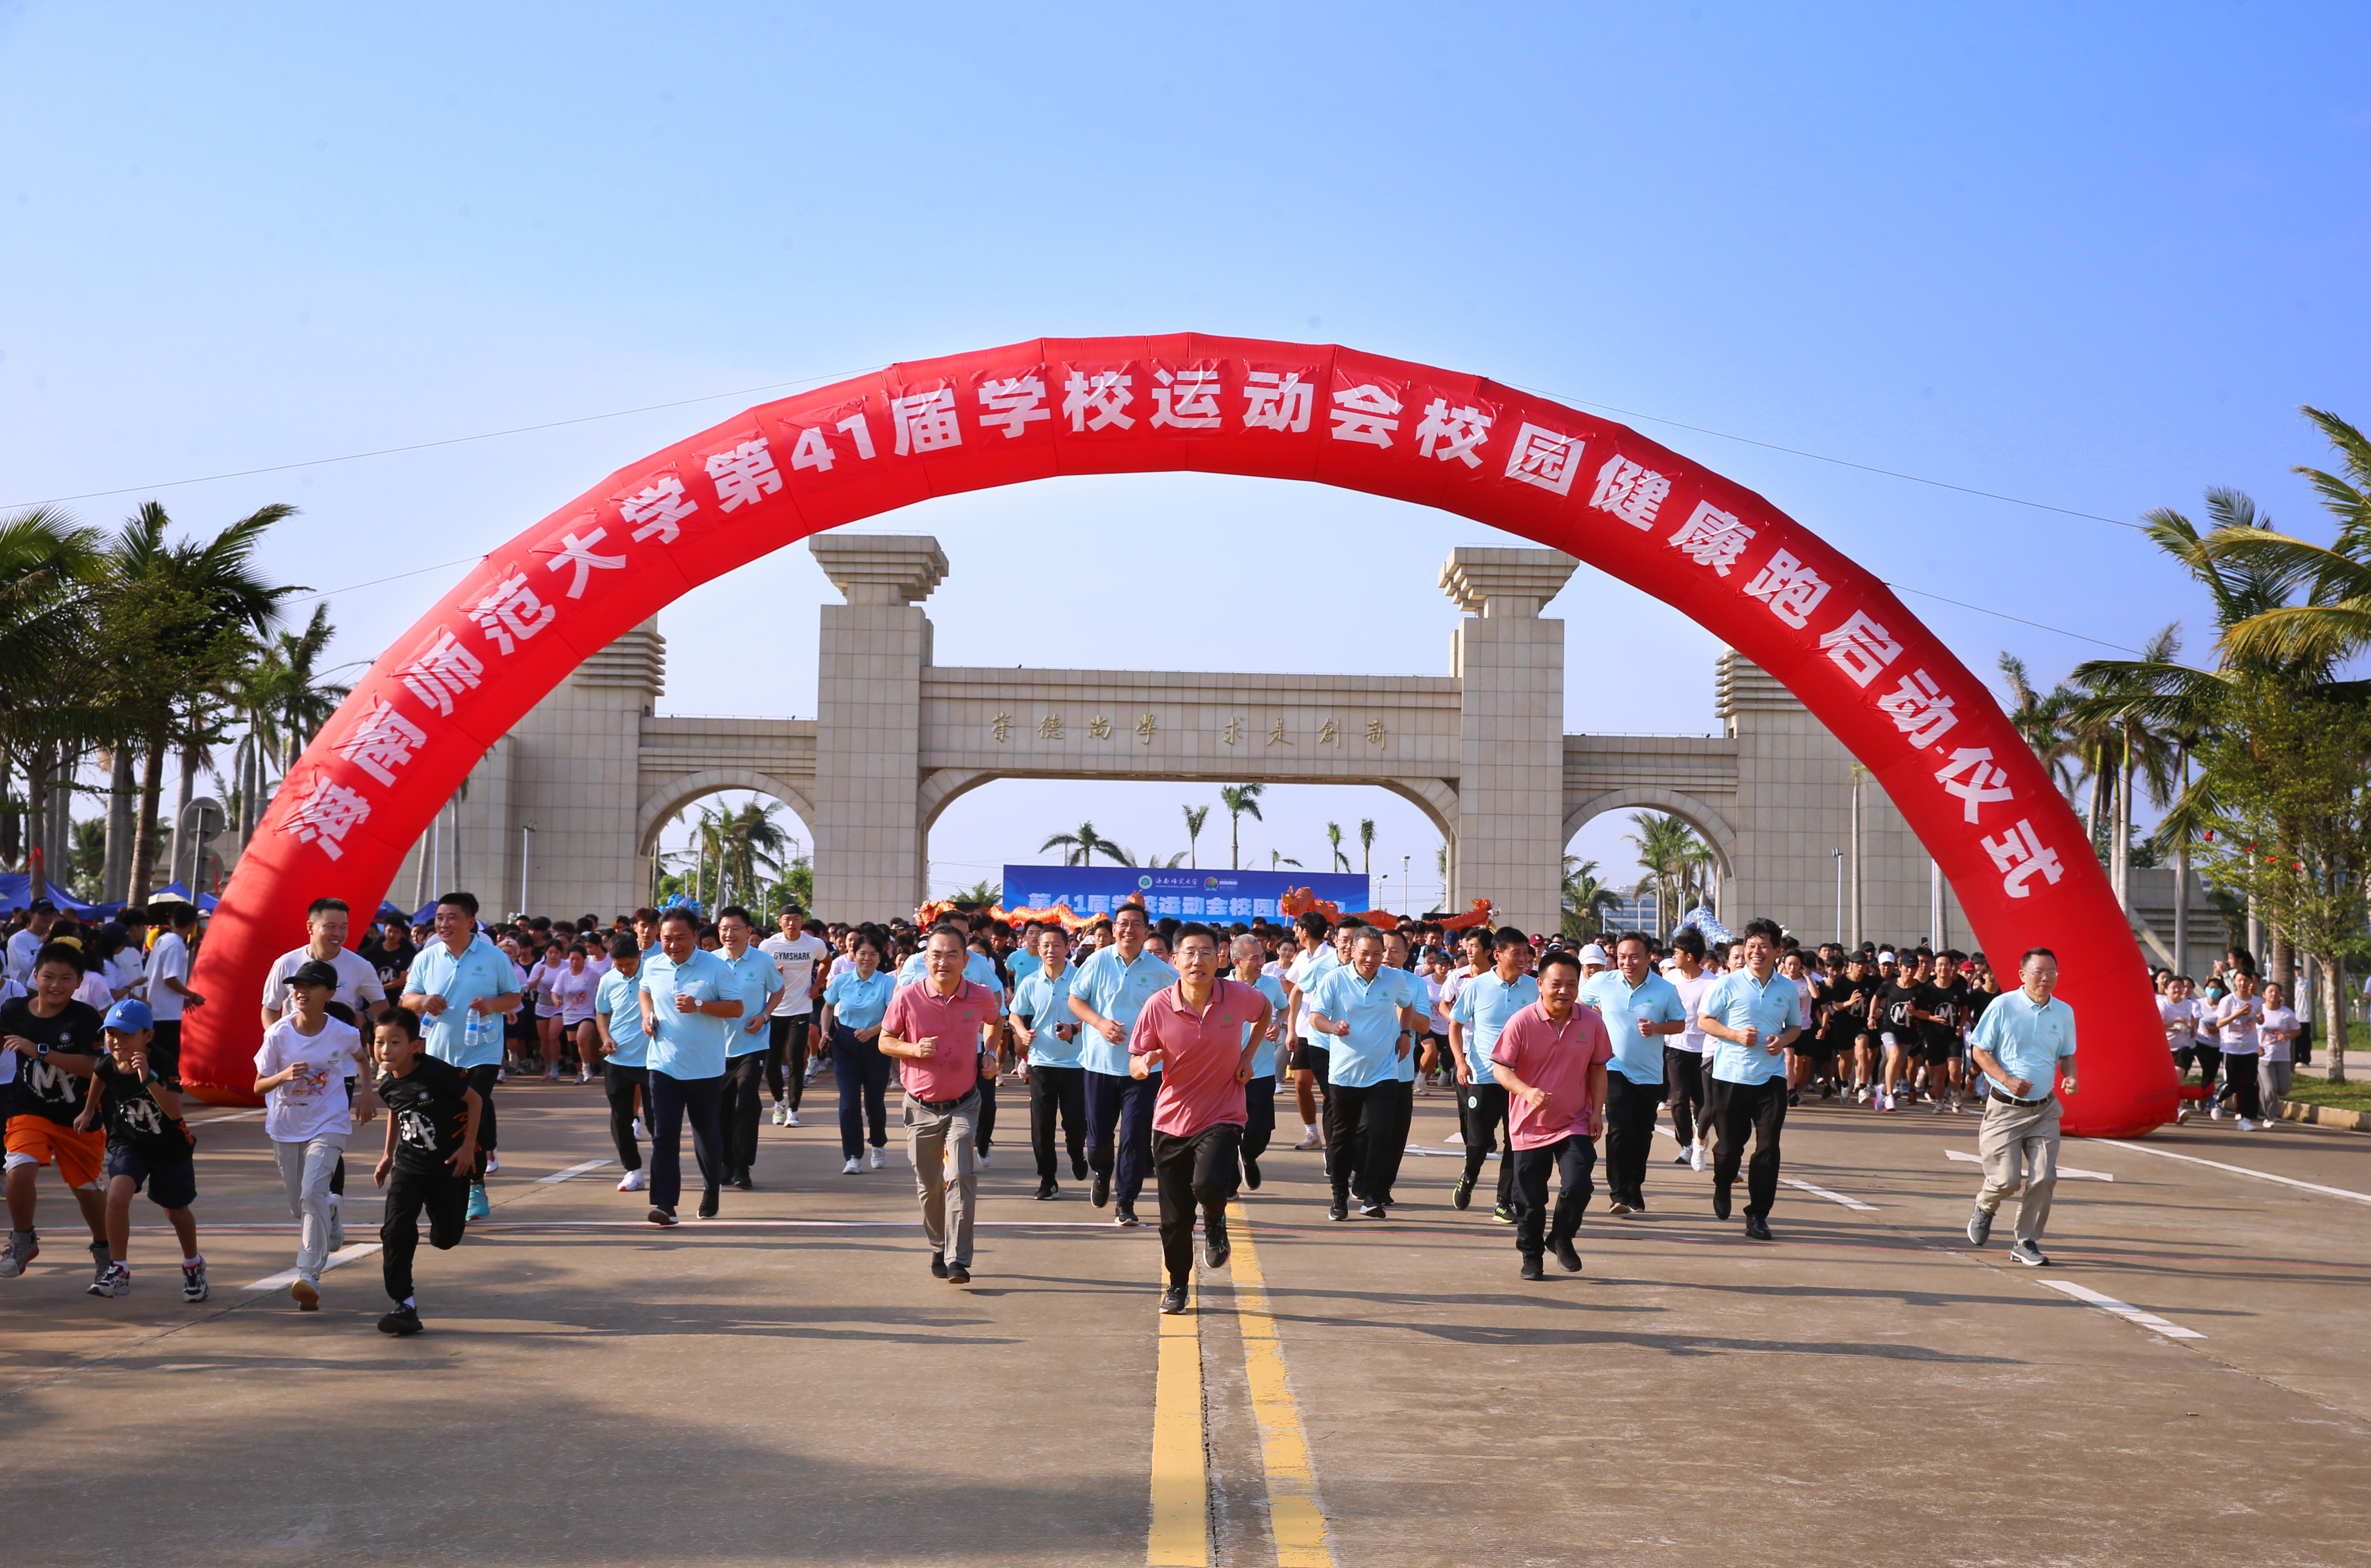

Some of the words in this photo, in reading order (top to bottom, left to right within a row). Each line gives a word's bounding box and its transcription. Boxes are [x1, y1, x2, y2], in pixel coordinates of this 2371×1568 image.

[288, 363, 2064, 899] 海南师范大学第41届学校运动会校园健康跑启动仪式
[774, 952, 810, 960] GYMSHARK
